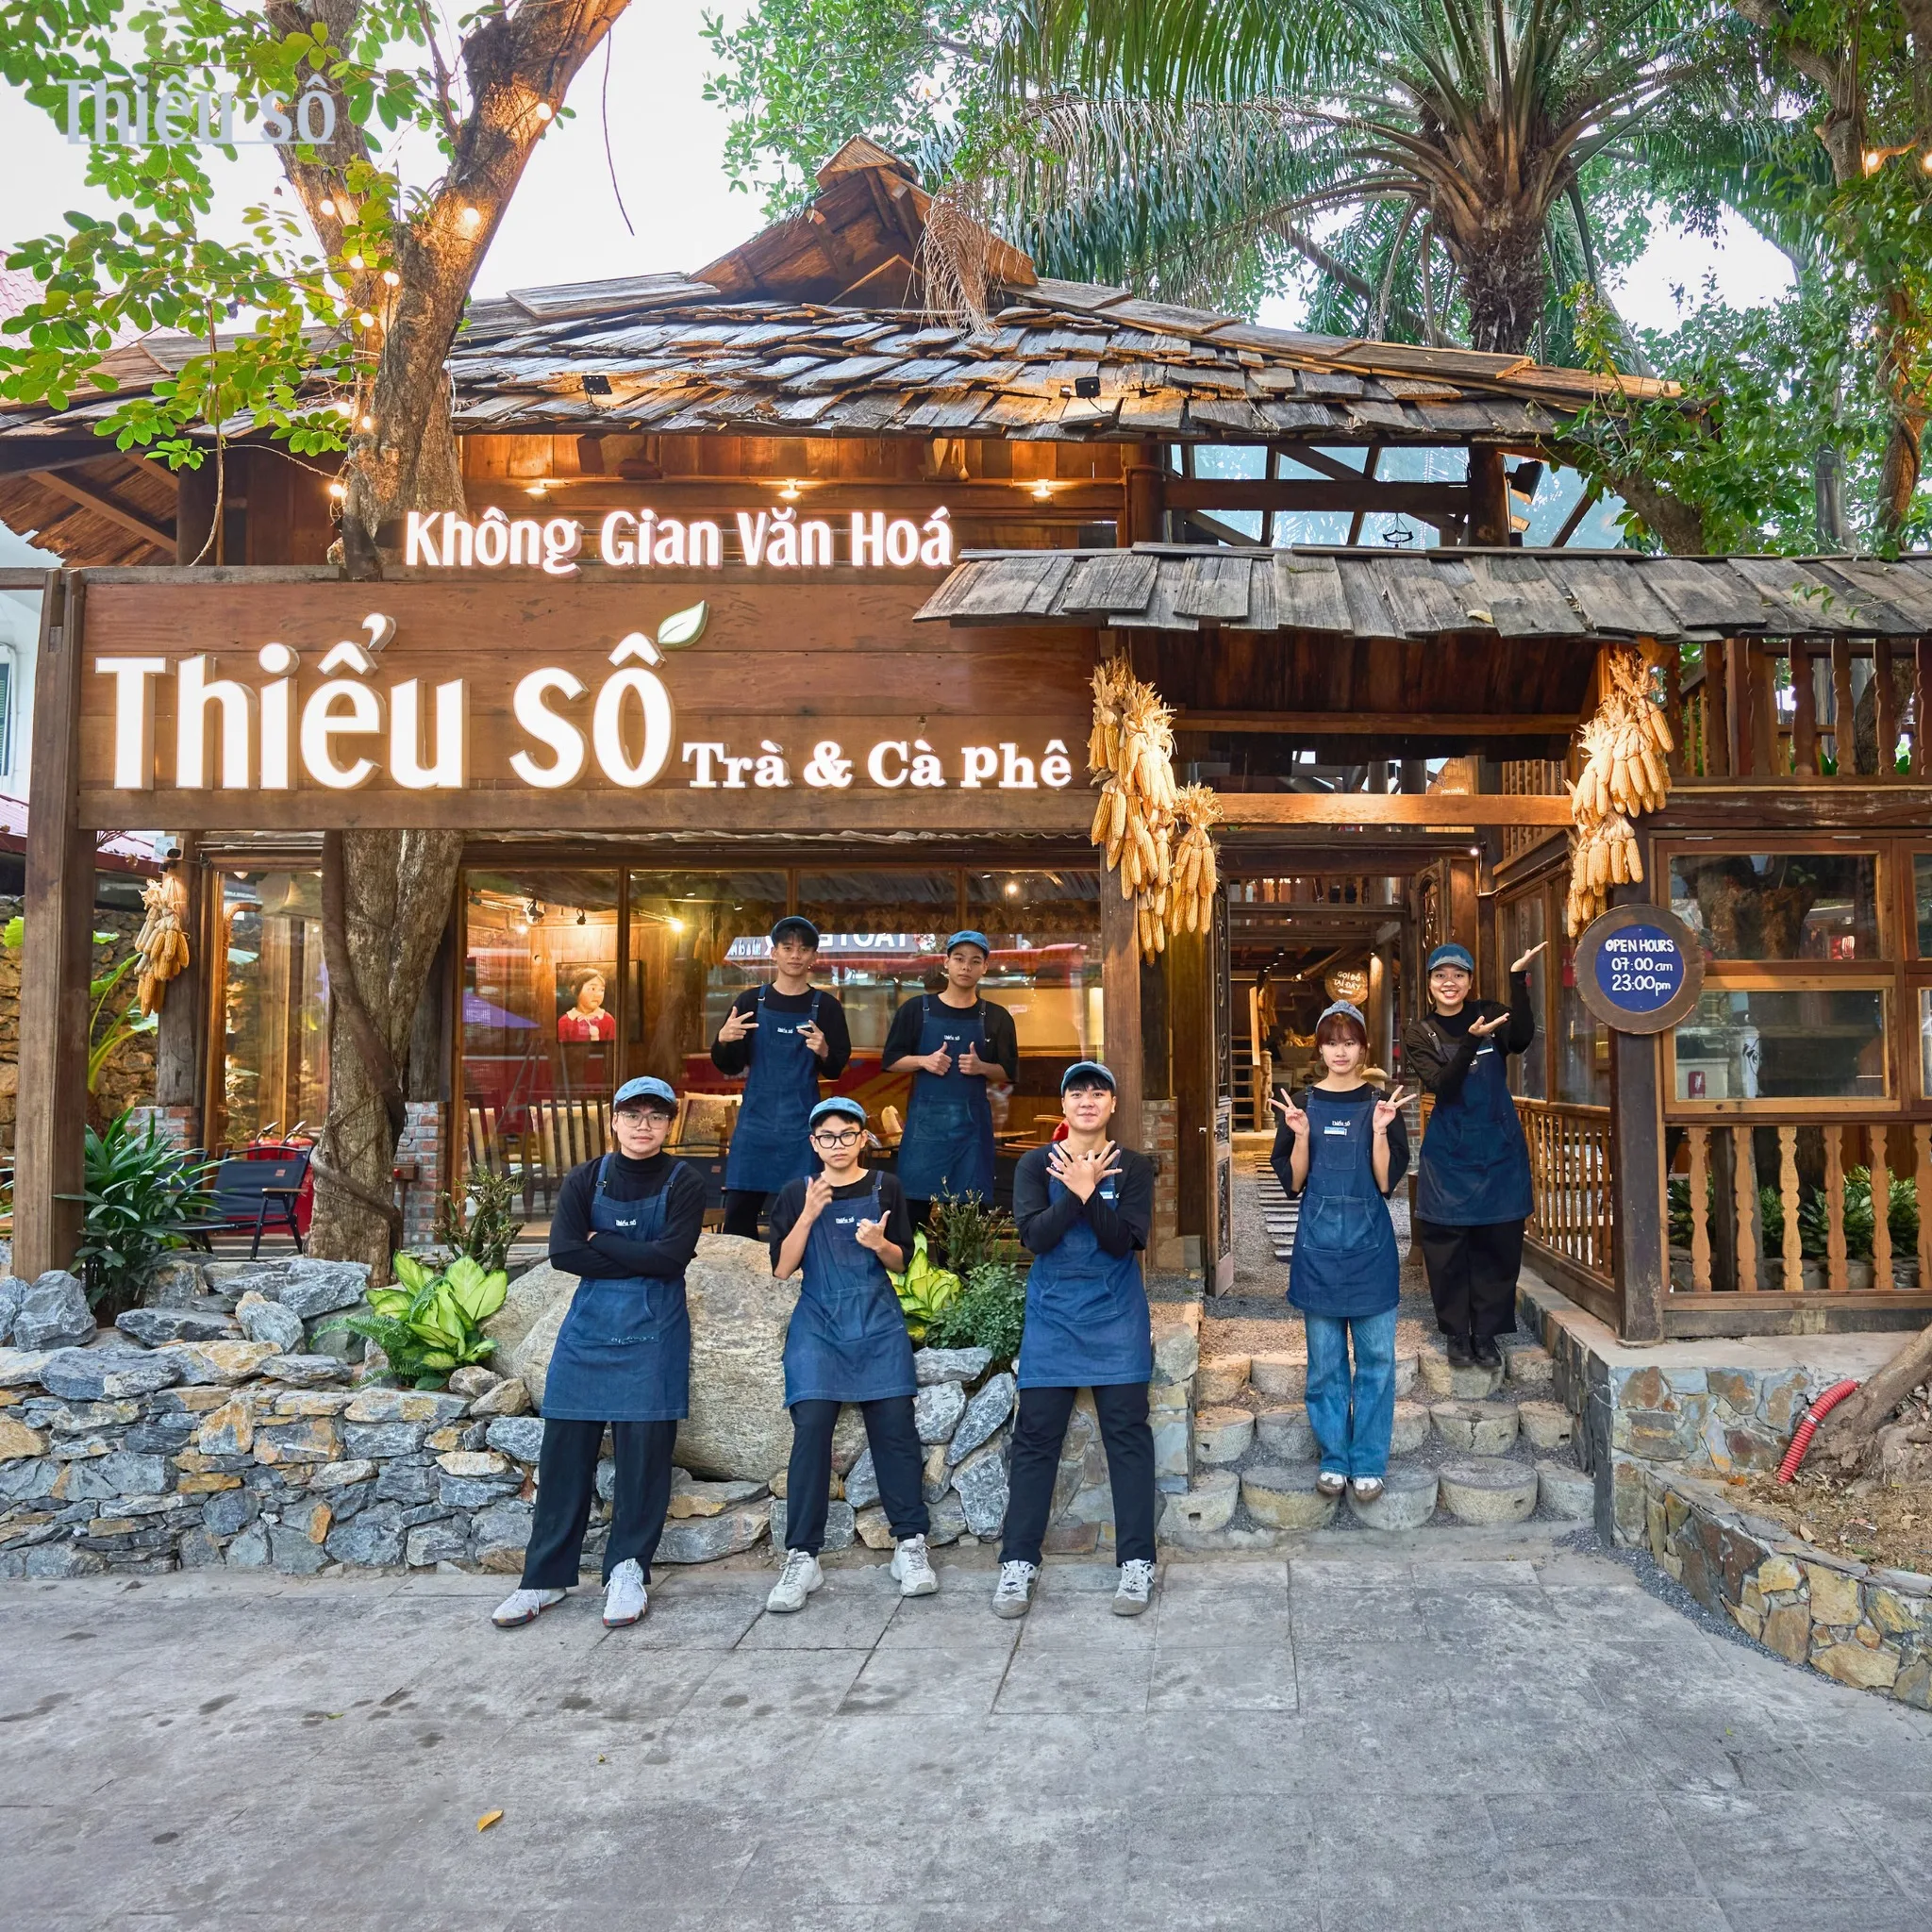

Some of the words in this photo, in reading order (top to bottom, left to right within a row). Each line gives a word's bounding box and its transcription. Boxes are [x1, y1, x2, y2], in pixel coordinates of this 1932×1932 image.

[405, 506, 583, 575] Không
[600, 508, 722, 567] Gian
[736, 506, 836, 567] Văn
[850, 506, 954, 567] Hoá
[95, 611, 473, 790] Thiểu
[681, 739, 792, 789] Trà
[802, 740, 855, 789] &
[866, 739, 947, 789] Cà
[1605, 938, 1638, 953] OPEN
[1639, 939, 1674, 953] HOURS
[1611, 957, 1654, 972] 07:00
[1655, 962, 1674, 972] am
